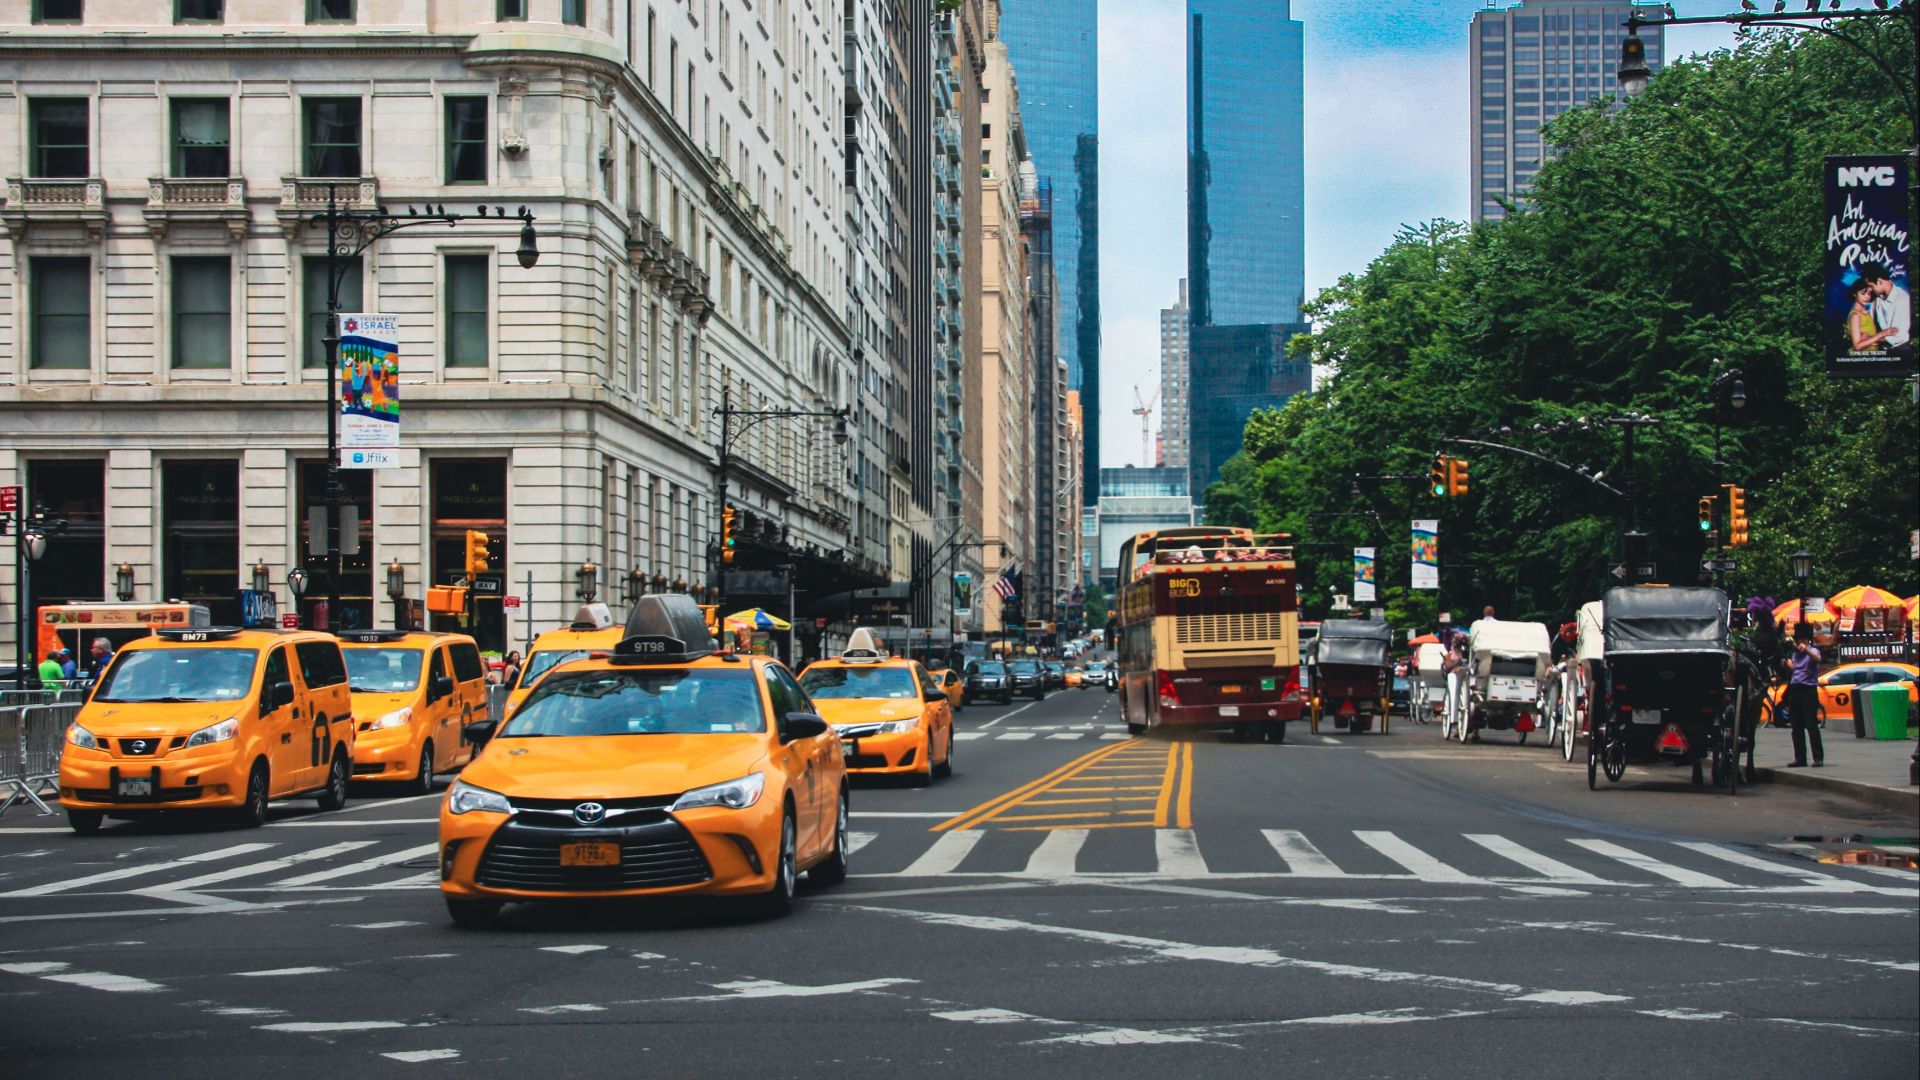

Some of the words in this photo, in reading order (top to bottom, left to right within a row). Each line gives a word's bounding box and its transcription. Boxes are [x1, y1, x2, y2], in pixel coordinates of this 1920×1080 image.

[1837, 166, 1895, 187] NYC
[1841, 193, 1864, 224] An
[1826, 214, 1910, 253] American
[1839, 243, 1893, 271] Paris
[360, 321, 396, 330] ISRAEL
[1169, 578, 1186, 589] BIG
[634, 641, 665, 653] 9T98
[1841, 645, 1888, 656] INDEPENDENCE
[1891, 645, 1904, 655] DAY
